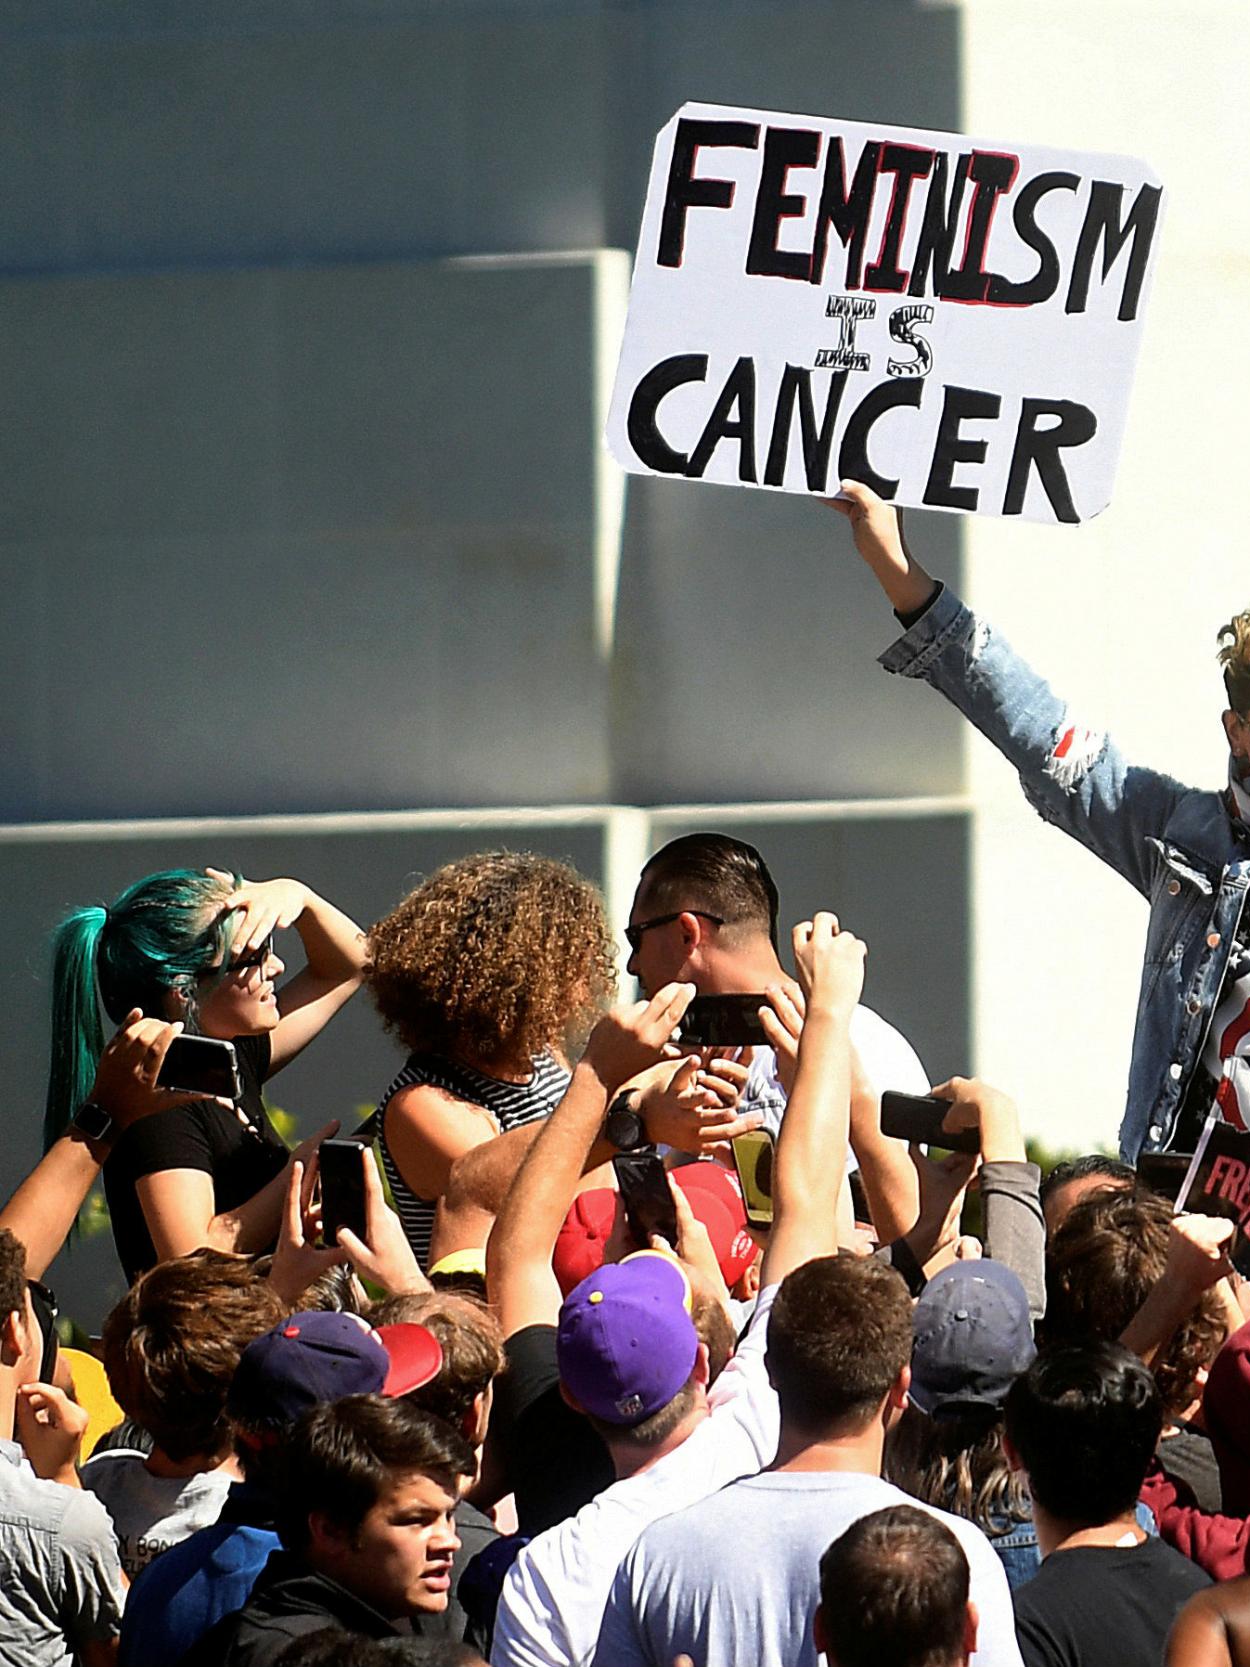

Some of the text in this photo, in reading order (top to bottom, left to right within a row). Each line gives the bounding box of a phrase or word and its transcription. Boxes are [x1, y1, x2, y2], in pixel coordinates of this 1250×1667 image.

[656, 118, 1163, 321] FEMINISM
[815, 294, 935, 377] IS
[627, 354, 1097, 523] CANCER
